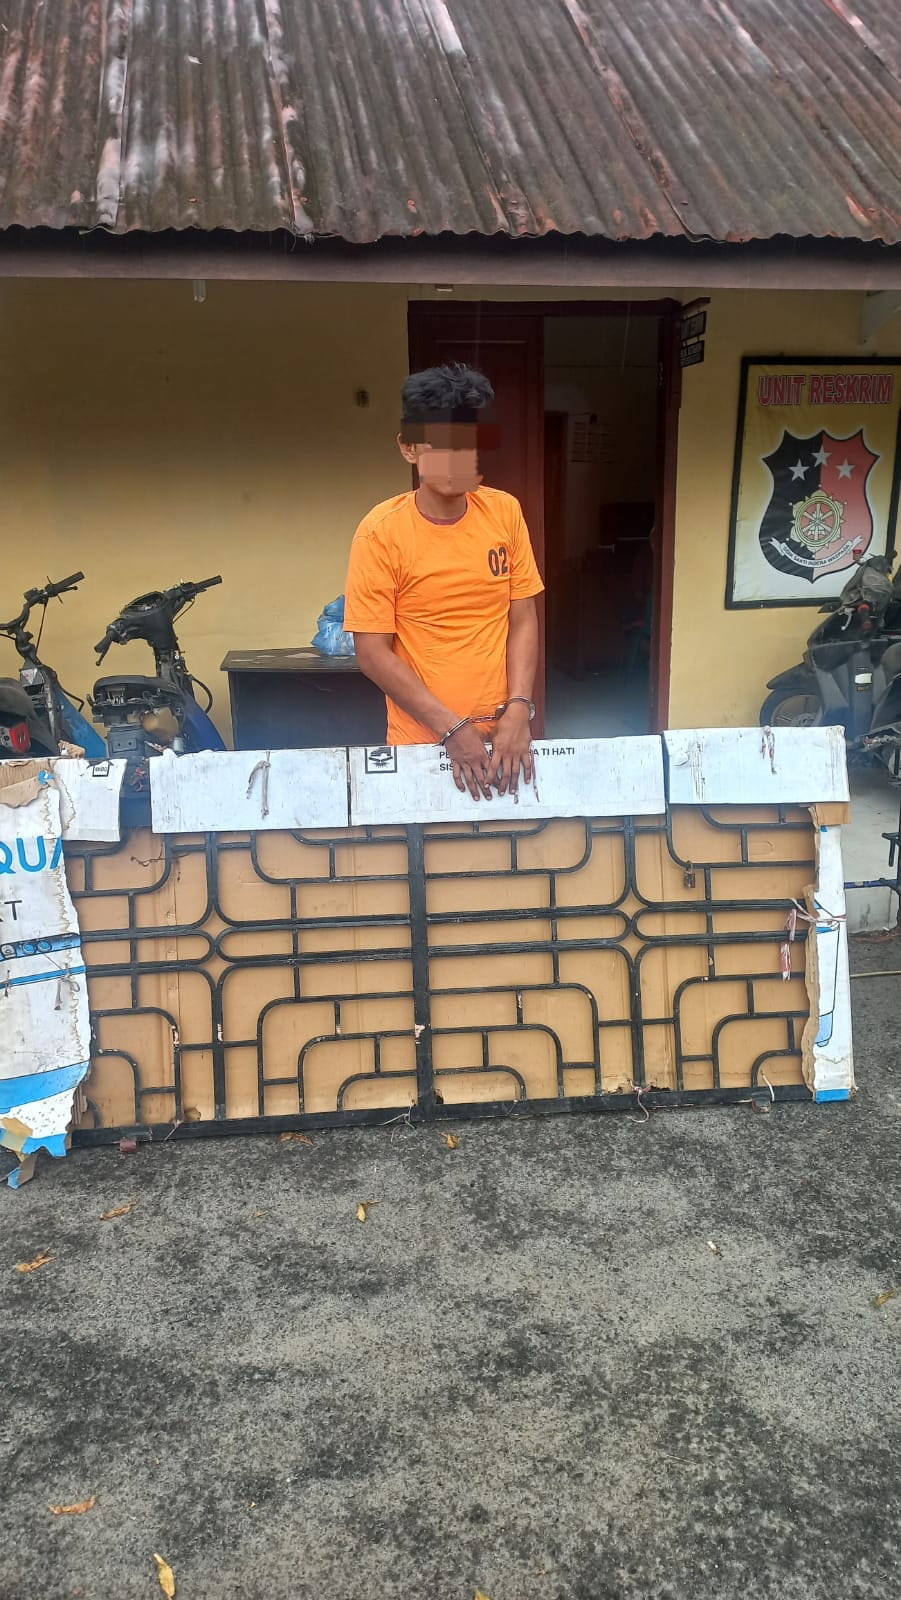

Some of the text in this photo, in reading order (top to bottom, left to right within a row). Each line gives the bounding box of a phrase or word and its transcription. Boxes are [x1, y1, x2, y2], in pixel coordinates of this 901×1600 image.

[759, 374, 893, 405] UNIT RESKRIM
[488, 546, 508, 576] 02
[793, 555, 808, 565] SAKTI
[551, 747, 575, 756] HATI
